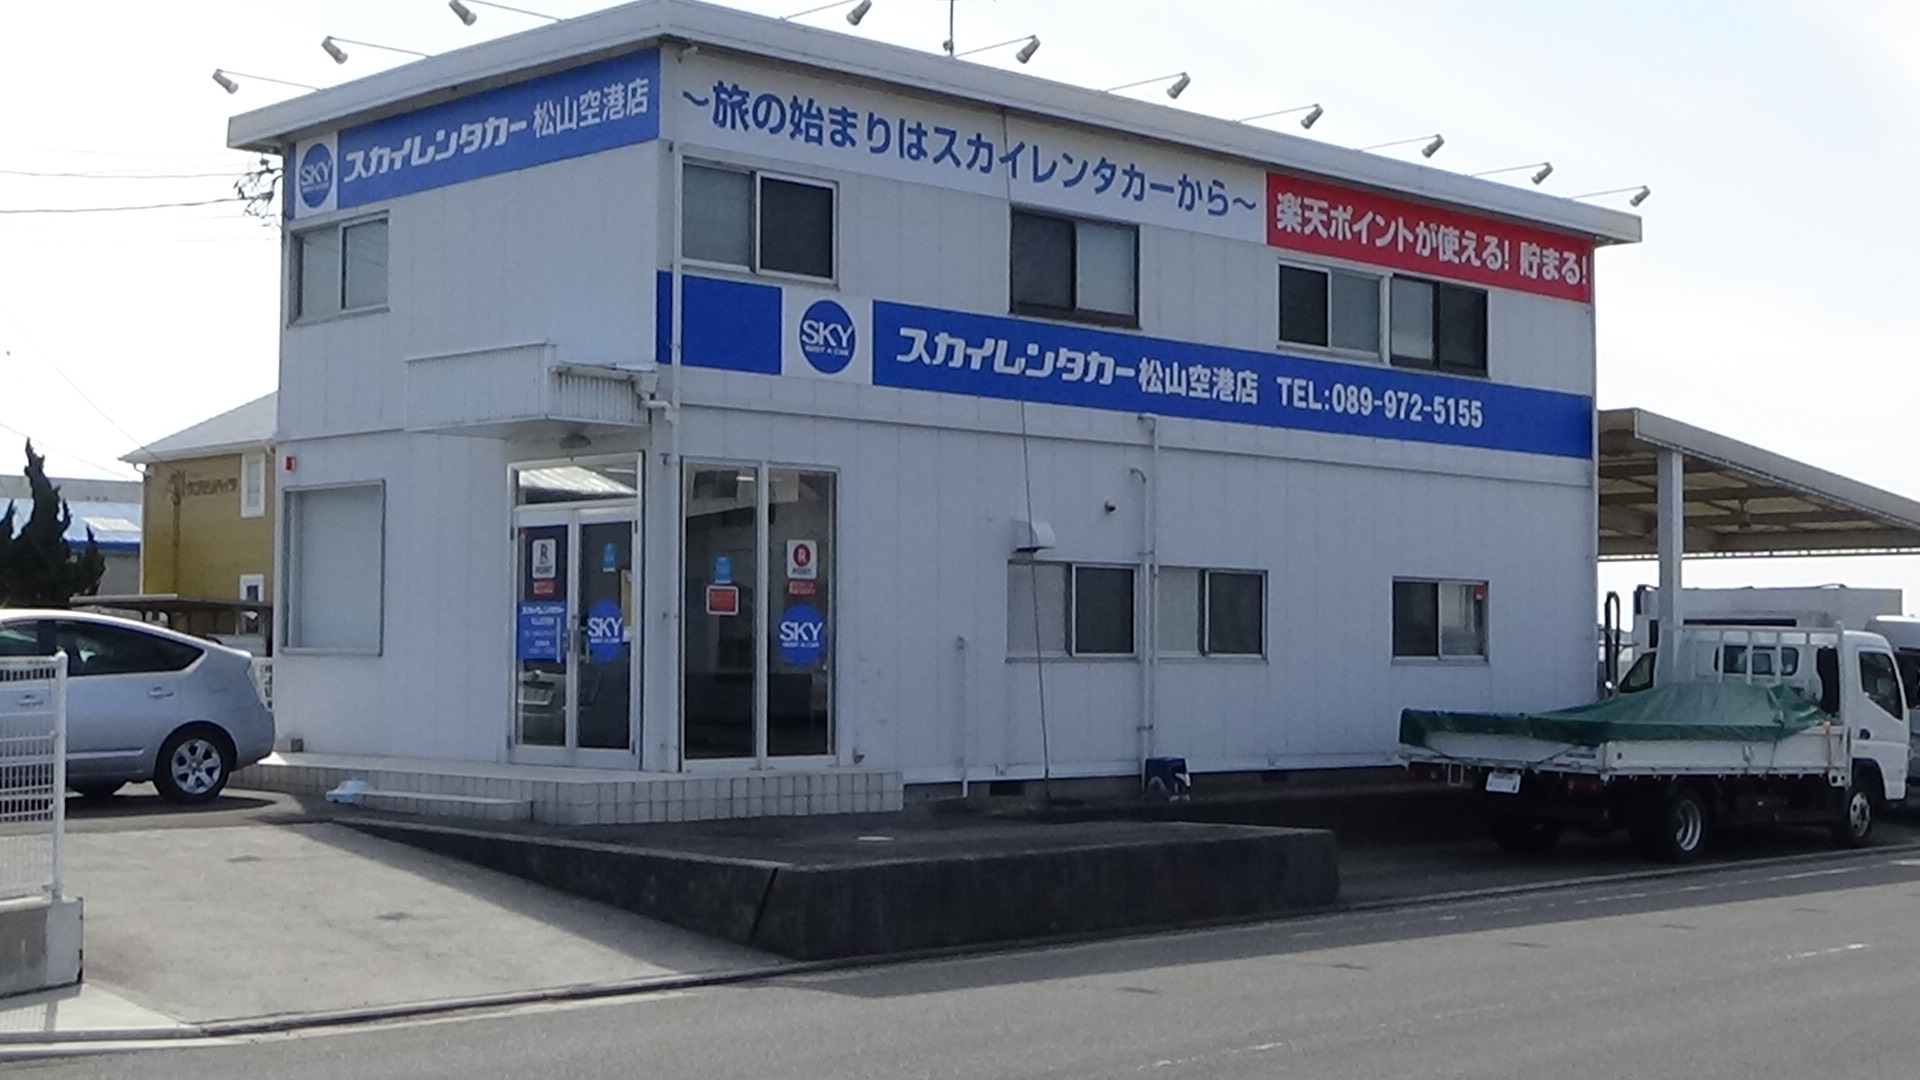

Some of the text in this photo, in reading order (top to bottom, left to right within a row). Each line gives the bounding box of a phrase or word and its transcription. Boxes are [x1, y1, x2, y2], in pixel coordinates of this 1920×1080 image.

[301, 160, 331, 186] SKY
[802, 319, 854, 348] SKY
[587, 617, 622, 637] SKY
[780, 620, 823, 640] SKY
